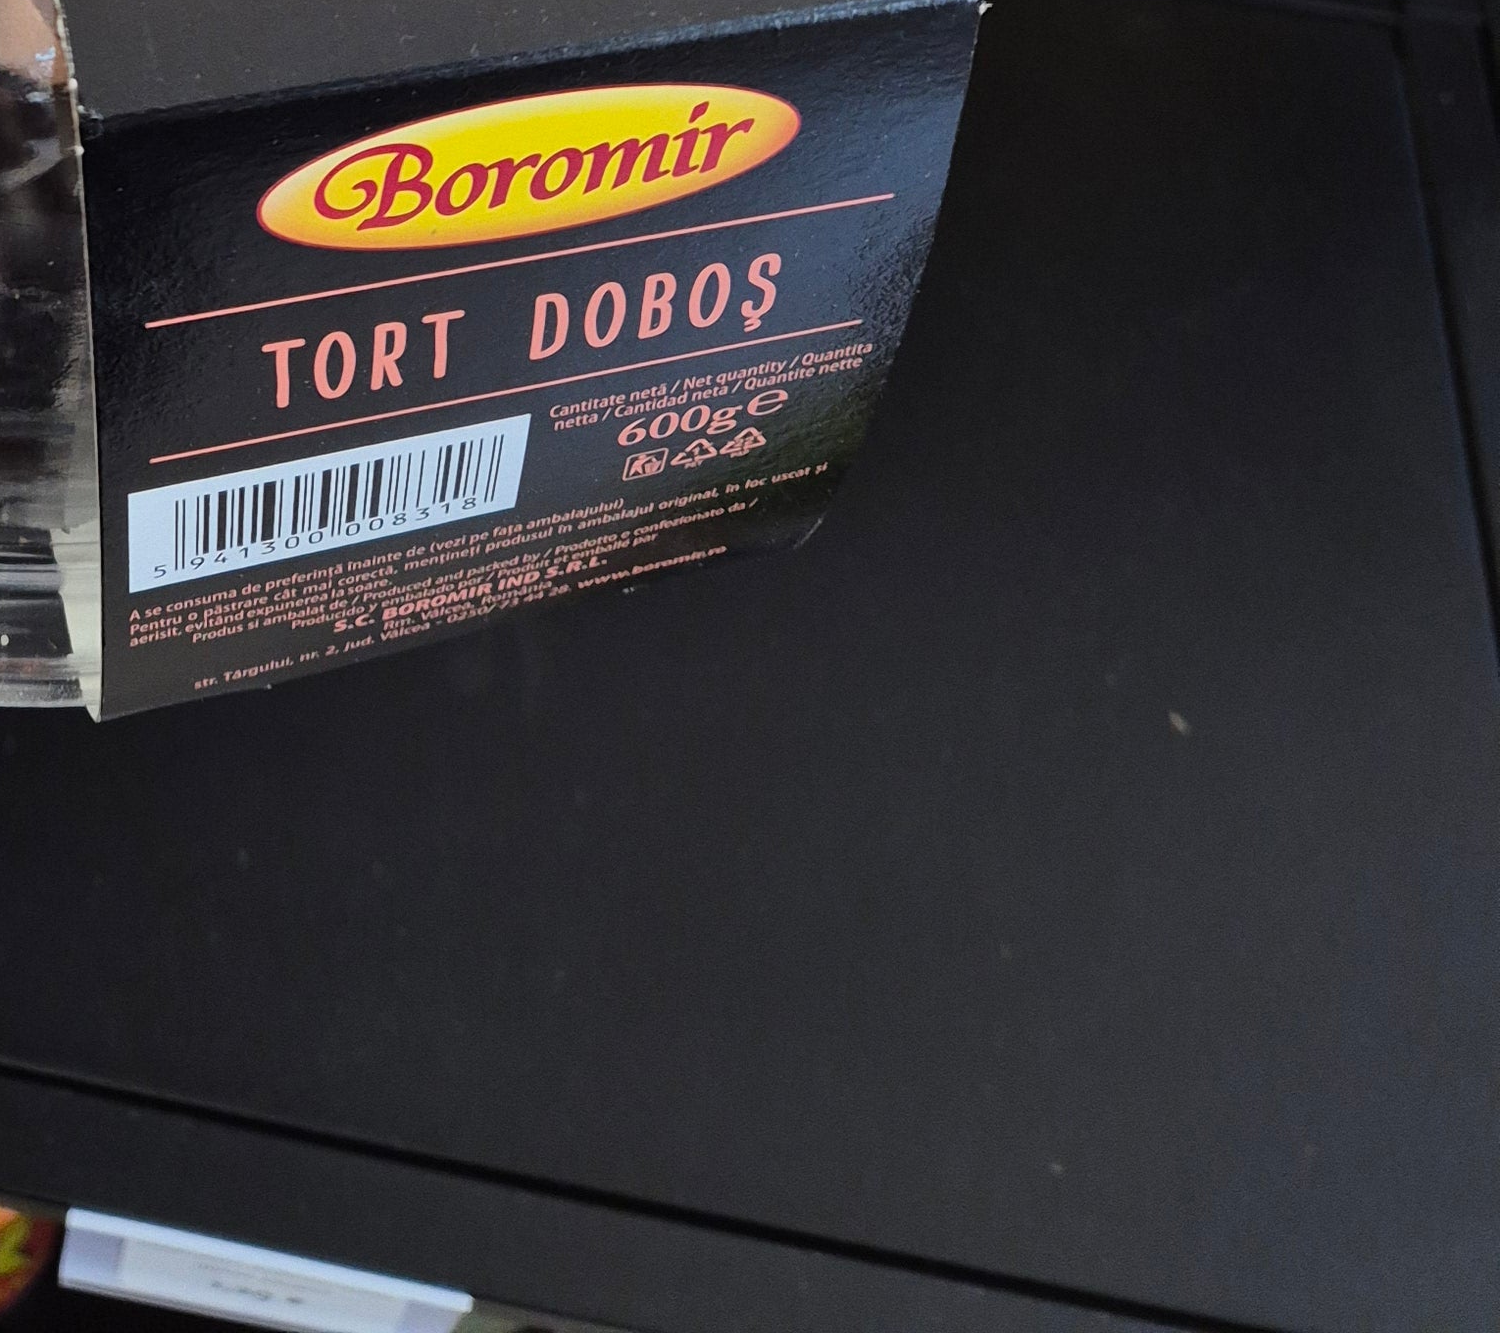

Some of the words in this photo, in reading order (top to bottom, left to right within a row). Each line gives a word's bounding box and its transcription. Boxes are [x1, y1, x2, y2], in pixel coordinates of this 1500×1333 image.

[312, 101, 756, 230] Boromir
[261, 309, 466, 410] TORT
[549, 394, 627, 419] Cantitate
[629, 383, 668, 403] netă
[683, 375, 713, 391] Net
[716, 359, 786, 385] quantity
[553, 412, 599, 432] netta
[614, 392, 687, 419] Cantidad
[691, 385, 729, 402] neta
[818, 355, 864, 376] nette
[129, 609, 141, 622] A
[144, 607, 161, 618] se
[166, 589, 237, 613] consuma
[241, 582, 261, 595] de
[406, 545, 425, 558] de
[430, 536, 467, 554] (vezi
[469, 532, 489, 545] pe
[526, 498, 624, 529] ambalajului)
[130, 615, 182, 634] Pentru
[203, 596, 267, 625] păstrare
[274, 587, 297, 601] cât
[303, 580, 333, 594] mai
[485, 528, 552, 553] produsul
[577, 502, 654, 531] ambalajul
[192, 623, 244, 643] Produs
[263, 603, 324, 626] ambalat
[329, 598, 347, 610] de
[364, 581, 432, 604] Produced
[436, 570, 463, 584] and
[467, 555, 519, 578] packed
[522, 551, 540, 567] by
[554, 534, 617, 556] Prodotto
[333, 614, 375, 633] S.C.
[382, 583, 492, 621] BOROMIR
[498, 570, 541, 591] IND
[544, 557, 608, 579] S.R.L.
[130, 628, 181, 647] aerisit,
[185, 610, 244, 632] evitând
[247, 595, 328, 620] expunerea
[331, 587, 345, 598] la
[347, 579, 392, 595] soare.
[291, 605, 365, 630] Producido
[381, 584, 454, 607] embalado
[194, 676, 218, 690] str.
